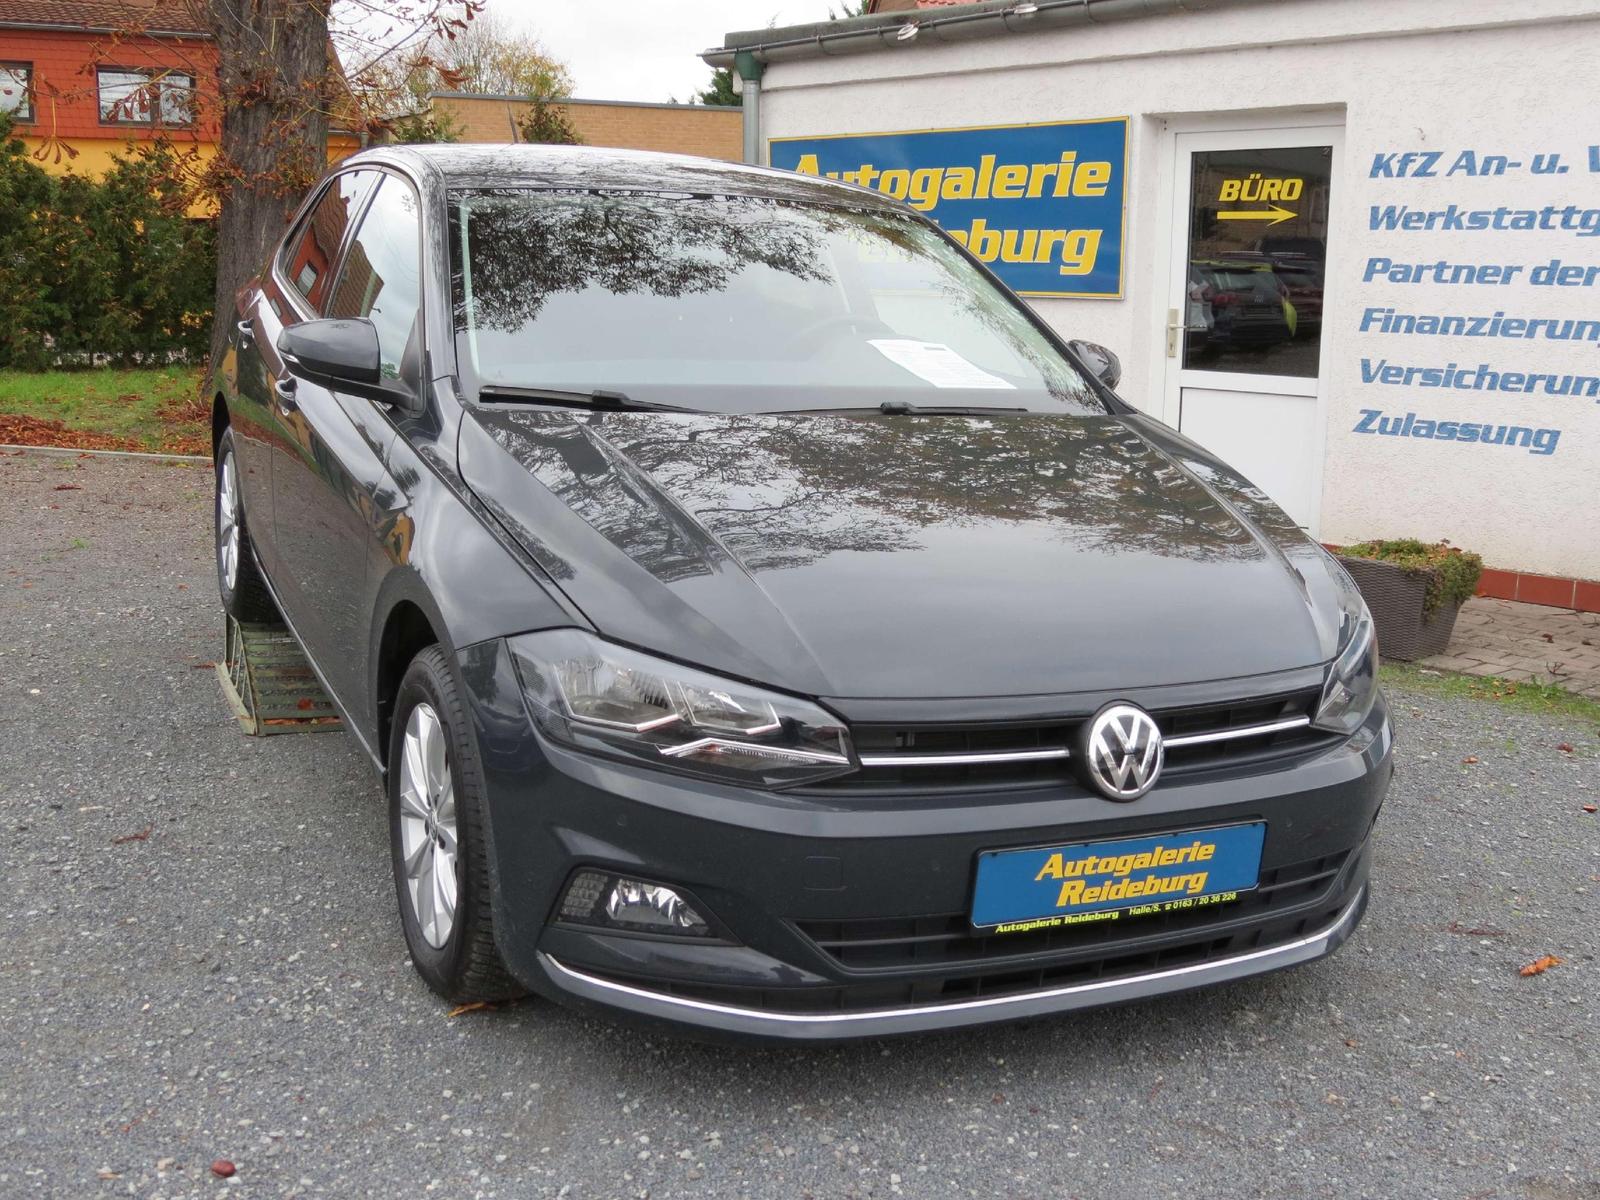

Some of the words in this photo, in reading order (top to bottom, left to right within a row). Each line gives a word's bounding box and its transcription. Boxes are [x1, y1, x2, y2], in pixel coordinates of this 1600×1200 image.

[1369, 153, 1442, 179] KfZ
[1446, 150, 1522, 177] An-
[1530, 153, 1570, 175] u.
[1218, 173, 1304, 203] BÜRO
[1362, 257, 1524, 285] Partner
[1359, 307, 1600, 348] Finanzierun
[1360, 358, 1600, 404] Versicherun
[1352, 408, 1562, 456] Zulassung
[1034, 841, 1216, 881] Autogalerie
[1056, 871, 1208, 907] Reideburg
[995, 917, 1062, 934] Autogalerie
[1064, 911, 1120, 924] Reideburg
